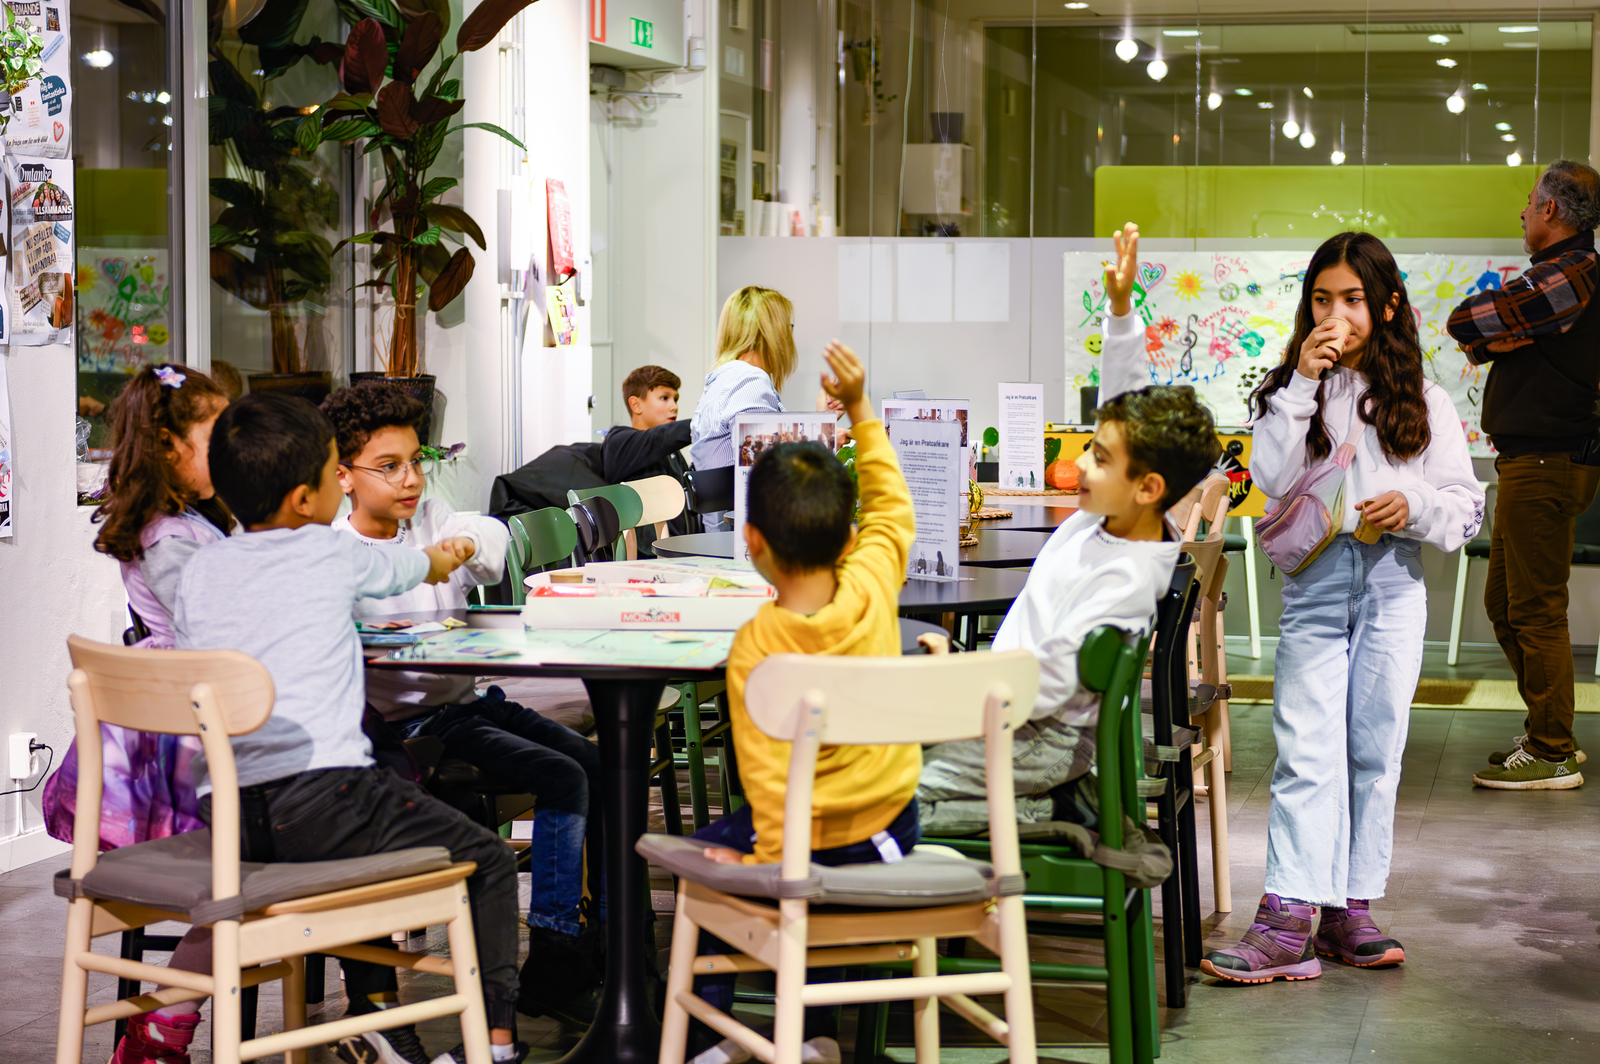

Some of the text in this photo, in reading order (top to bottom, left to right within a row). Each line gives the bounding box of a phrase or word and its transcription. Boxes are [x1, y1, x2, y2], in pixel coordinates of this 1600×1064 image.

[18, 166, 52, 183] Omtanke
[34, 226, 53, 246] STÄLLER
[899, 438, 908, 447] Jag
